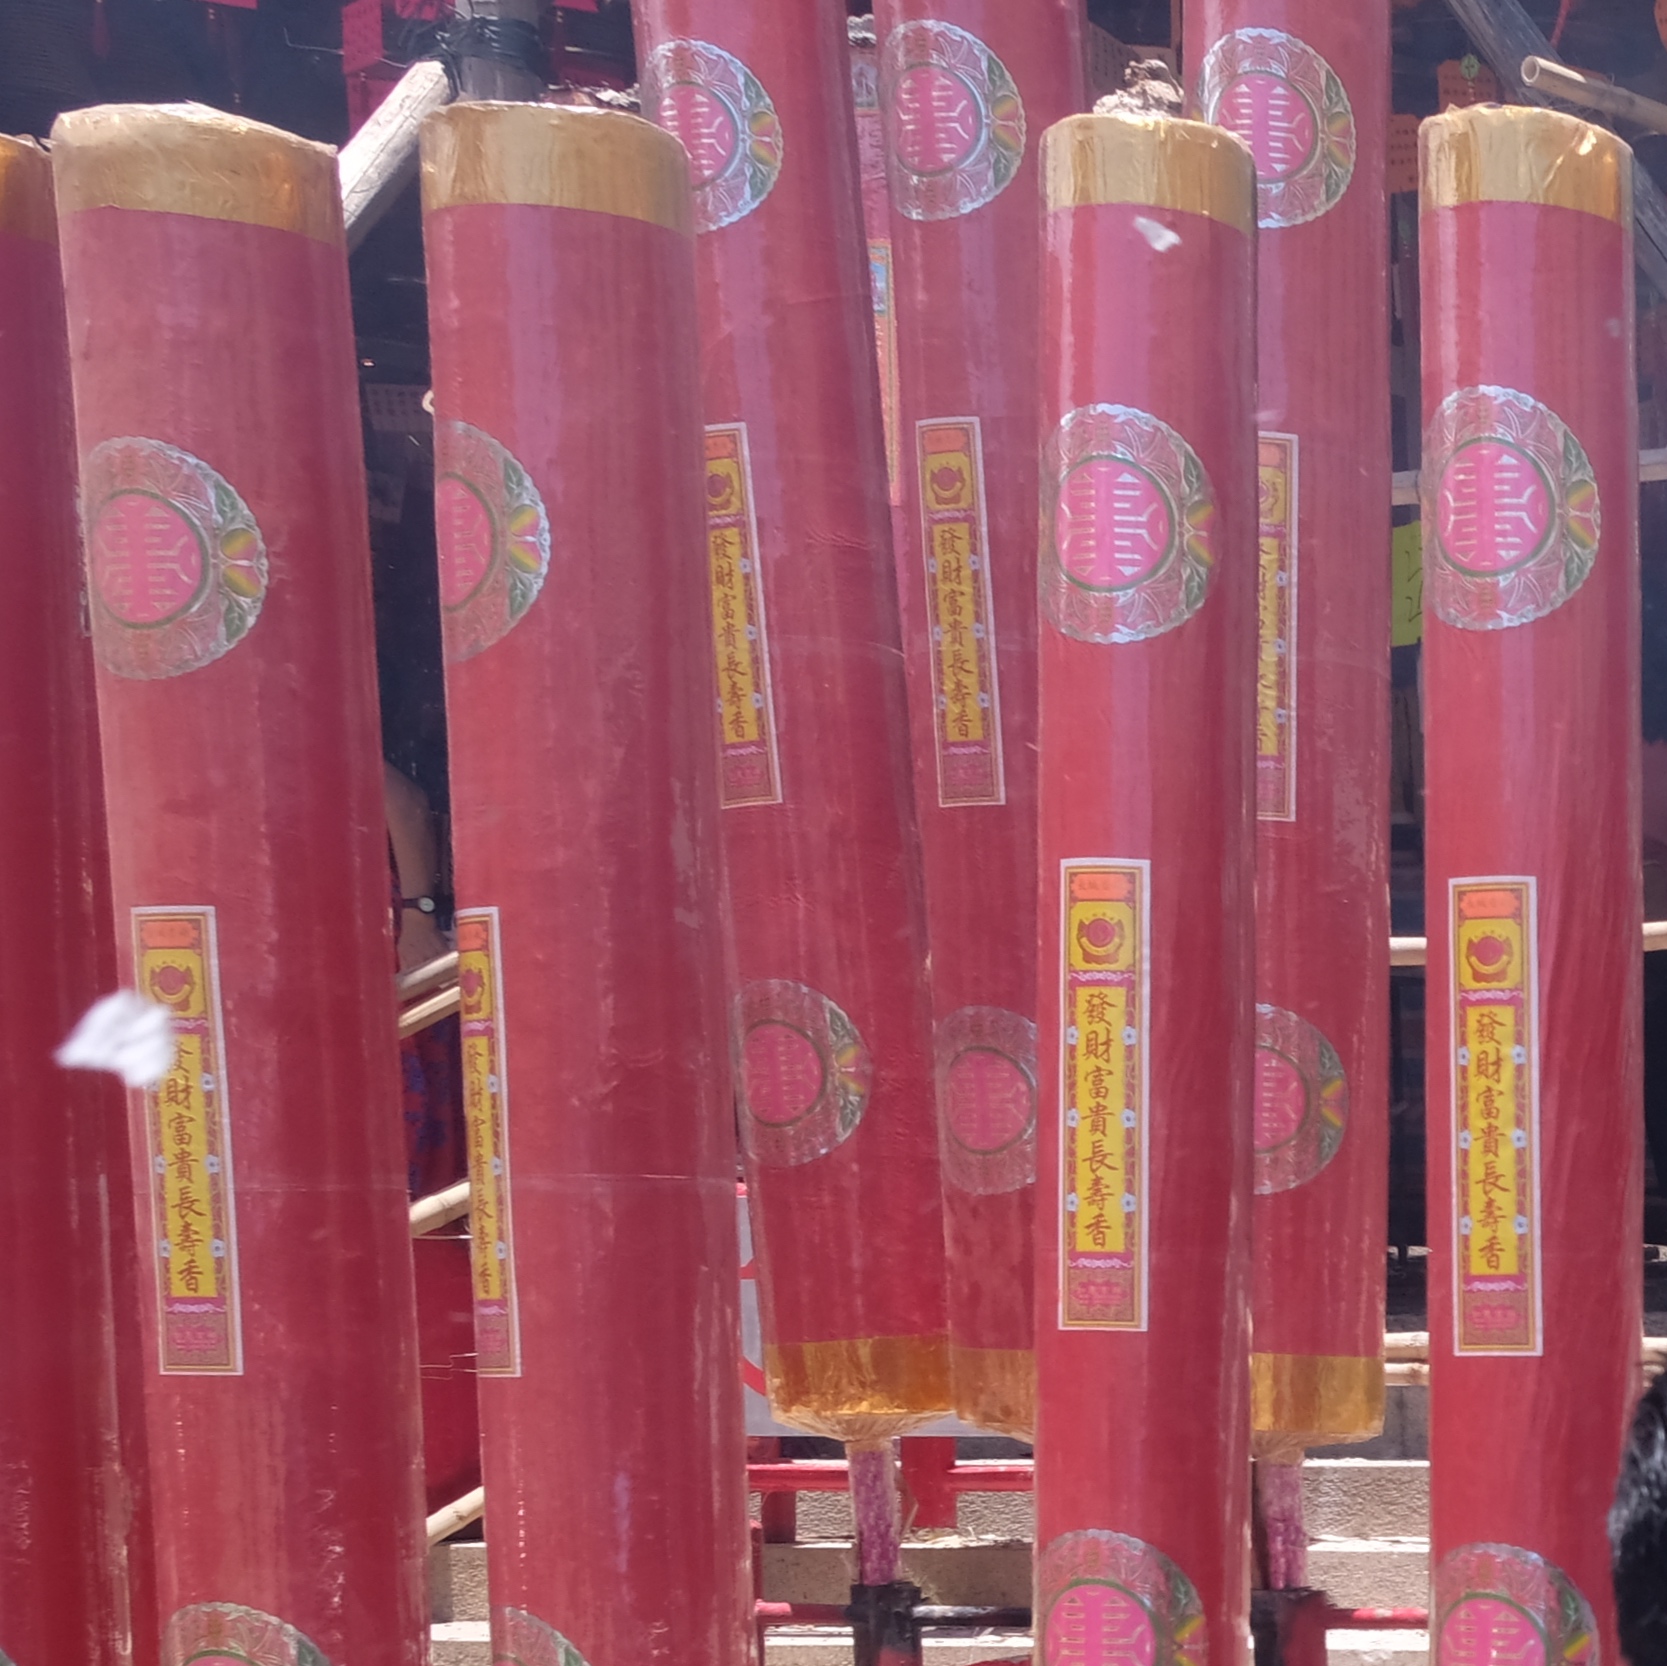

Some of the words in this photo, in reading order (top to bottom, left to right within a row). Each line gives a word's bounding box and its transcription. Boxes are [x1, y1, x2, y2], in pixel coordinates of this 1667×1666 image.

[938, 527, 975, 739] 發財富貴長壽香
[1081, 990, 1119, 1249] 發財富貴長壽香
[1472, 1010, 1511, 1272] 發財富貴長壽香
